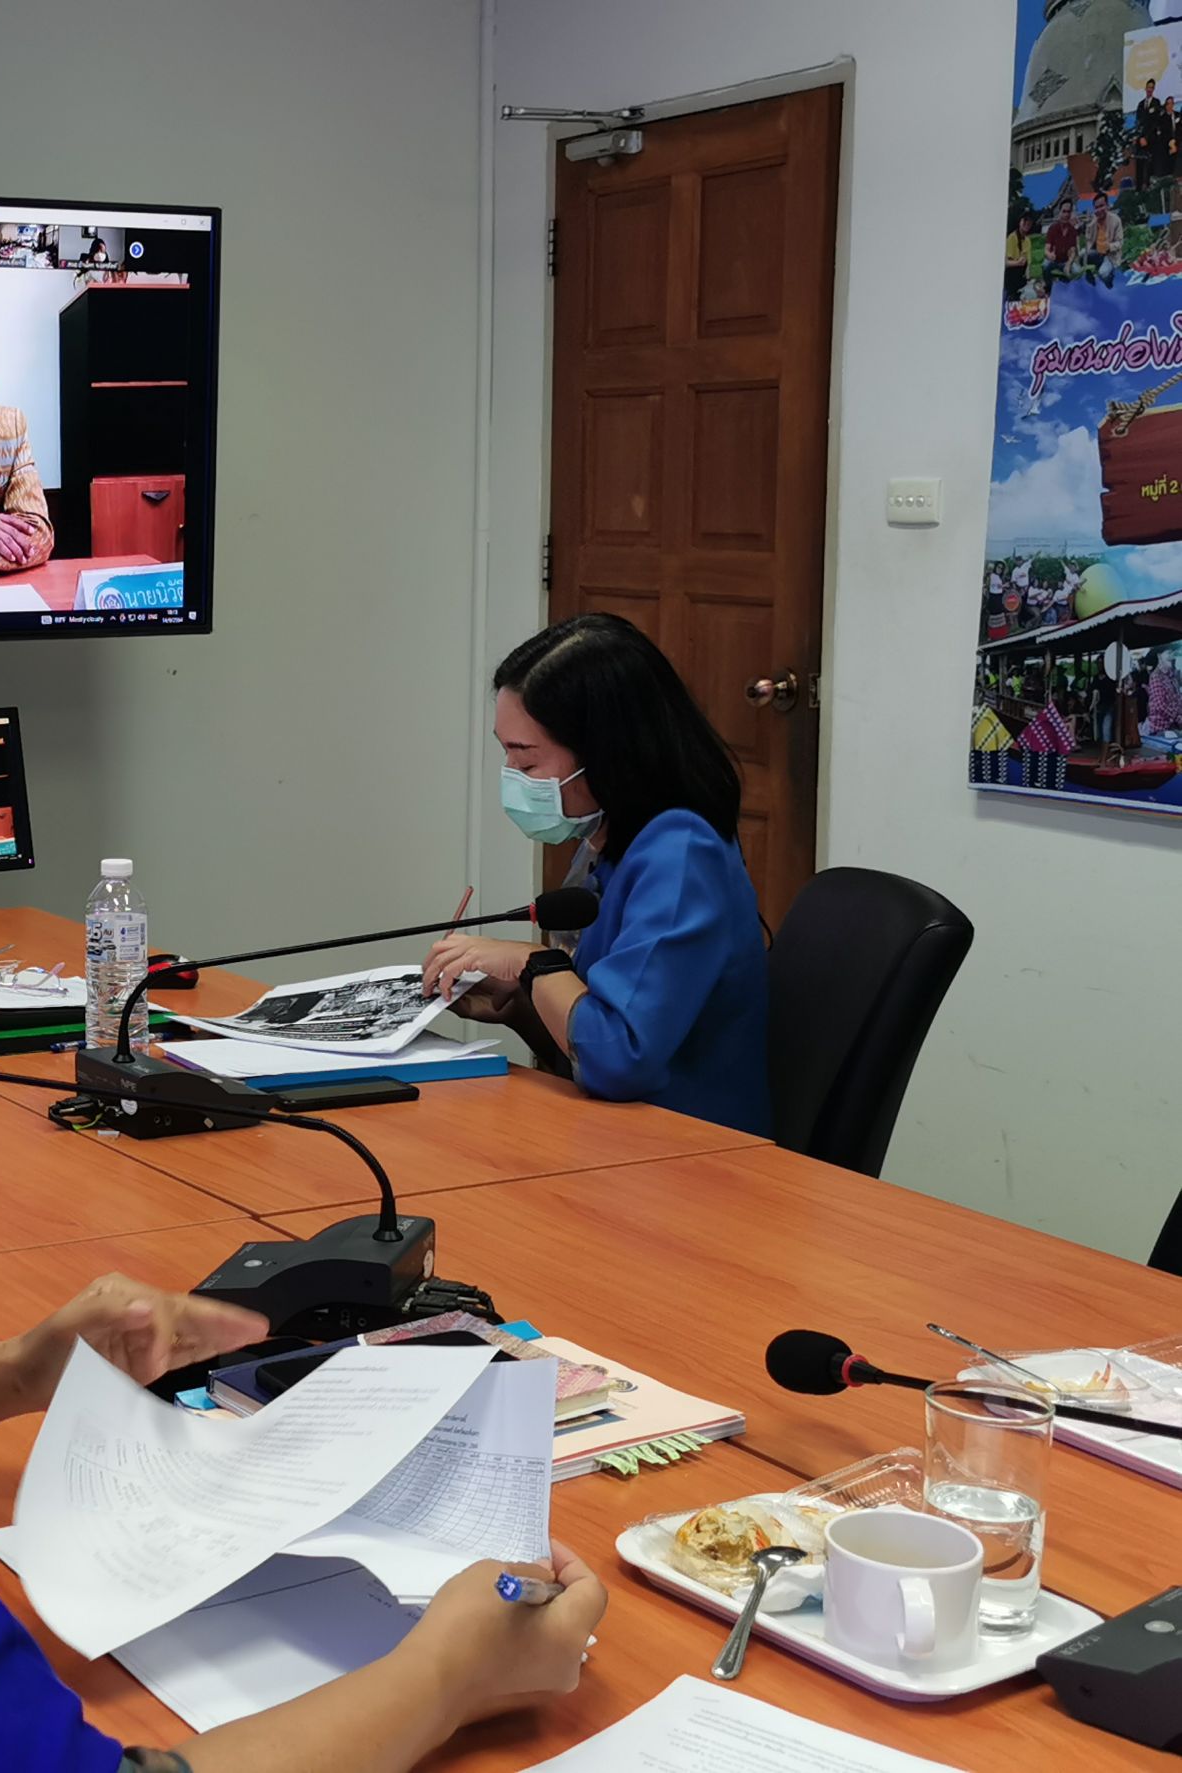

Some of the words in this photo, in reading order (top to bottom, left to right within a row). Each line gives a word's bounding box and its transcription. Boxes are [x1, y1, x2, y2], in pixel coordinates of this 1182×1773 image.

[1141, 474, 1167, 501] หมู่ที่
[1169, 480, 1178, 493] 2
